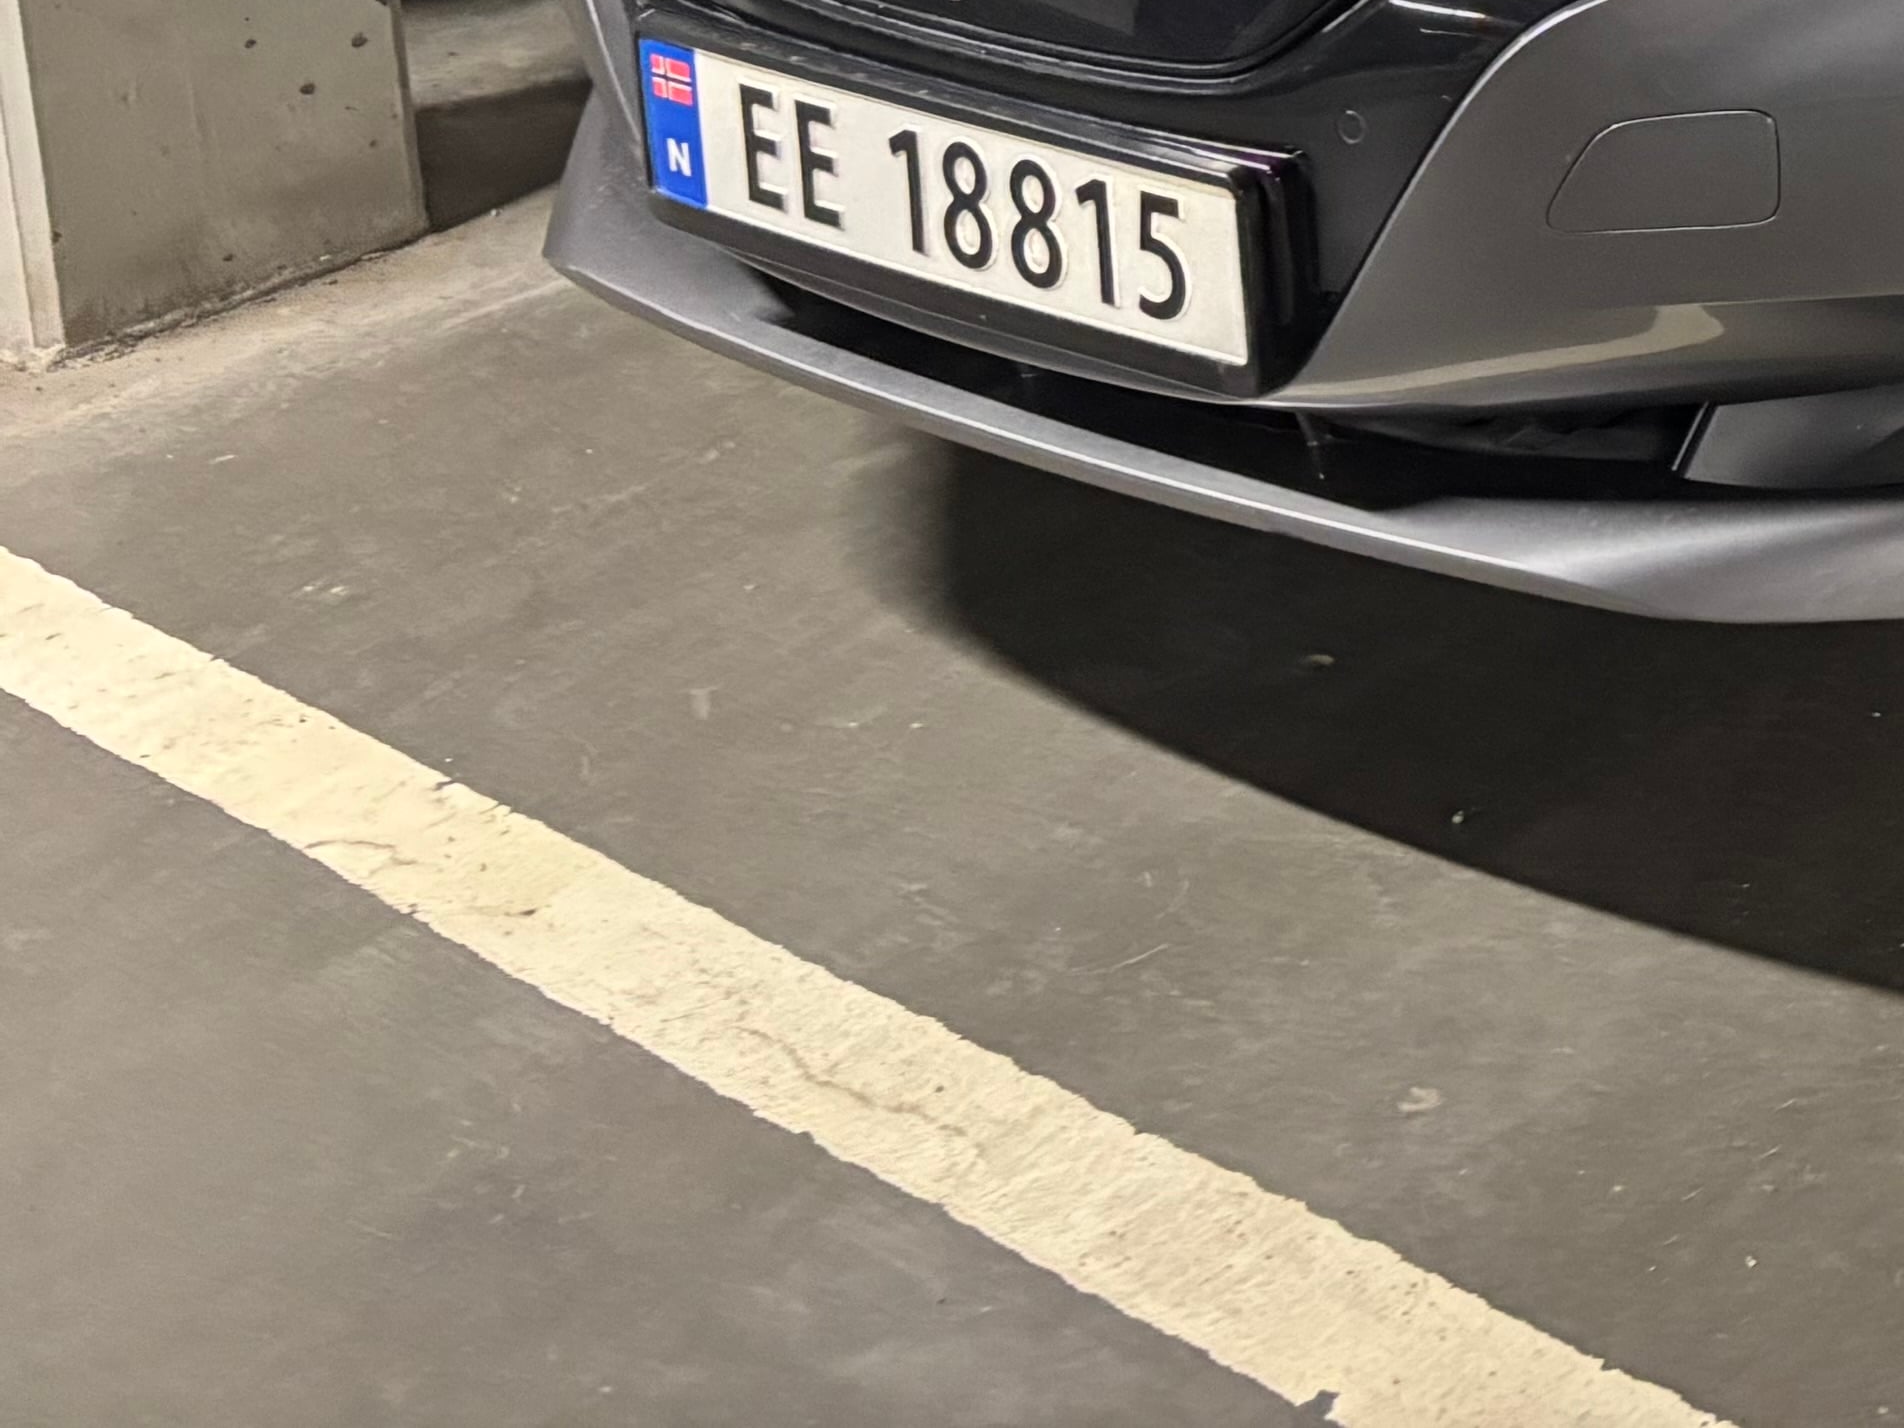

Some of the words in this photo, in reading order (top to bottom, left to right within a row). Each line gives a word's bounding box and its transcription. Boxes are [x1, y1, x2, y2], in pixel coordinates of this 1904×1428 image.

[667, 137, 692, 177] N
[739, 83, 843, 229] EE
[888, 129, 1186, 321] 18815
